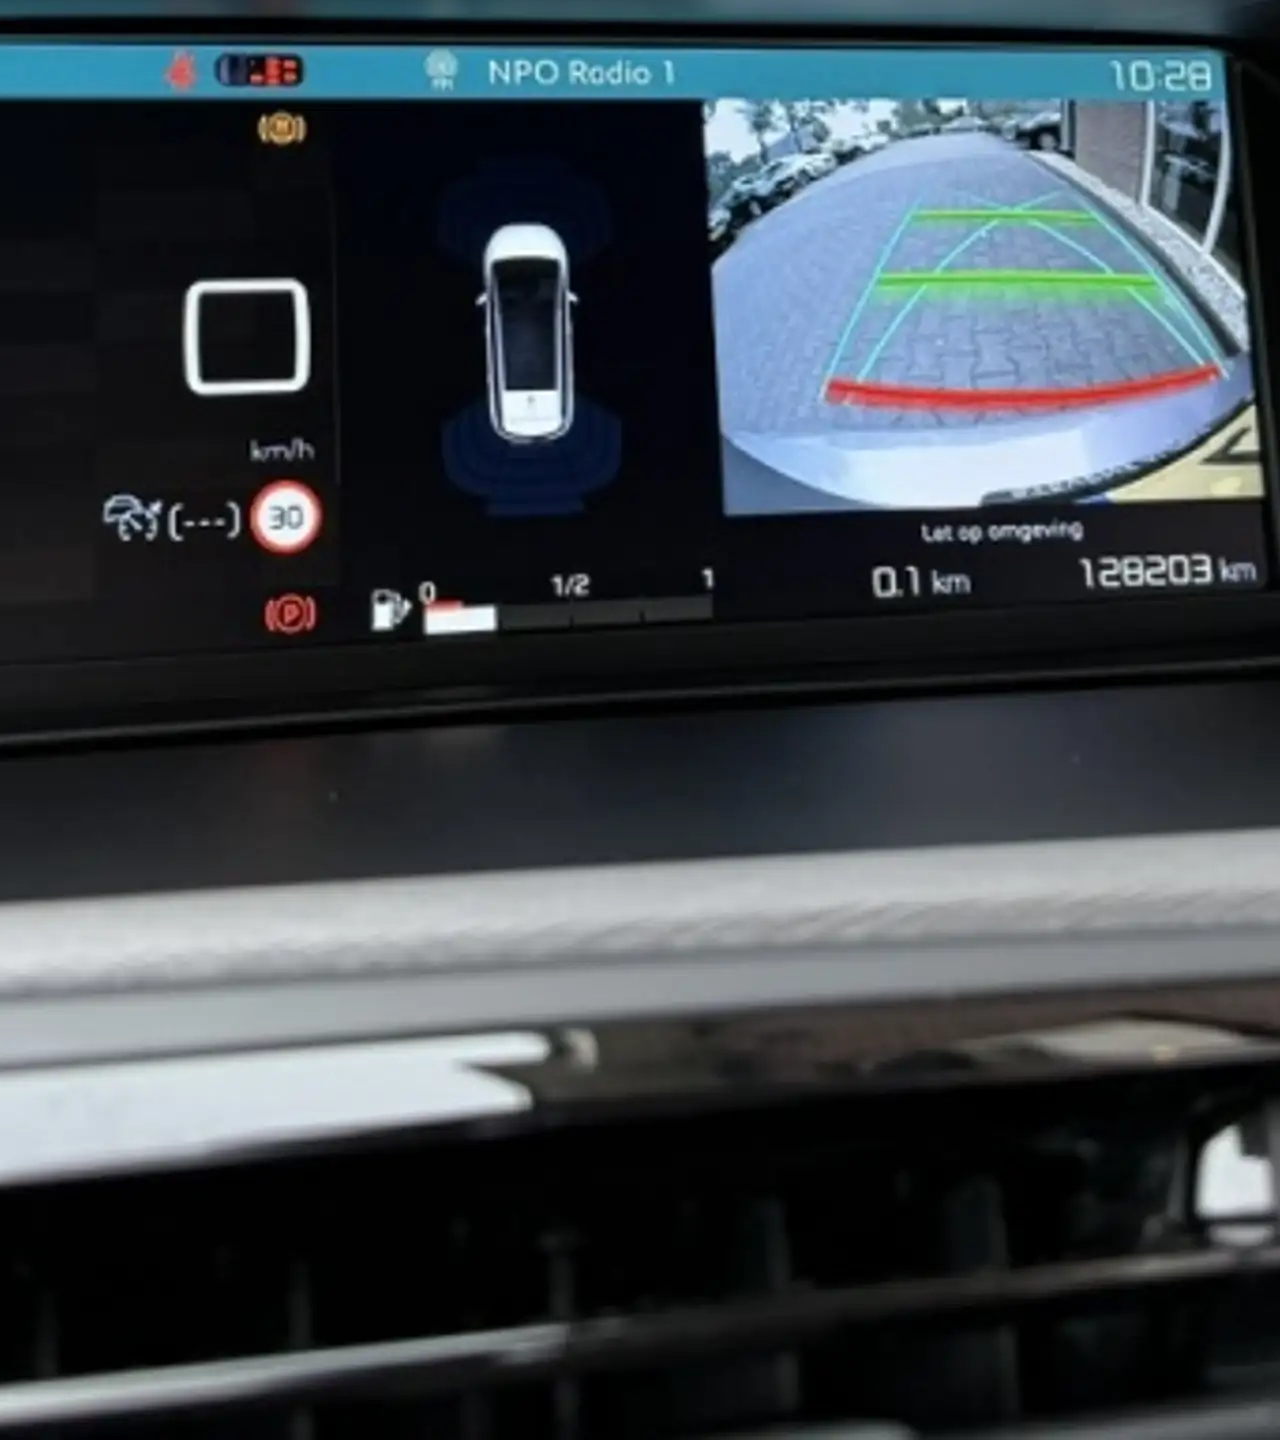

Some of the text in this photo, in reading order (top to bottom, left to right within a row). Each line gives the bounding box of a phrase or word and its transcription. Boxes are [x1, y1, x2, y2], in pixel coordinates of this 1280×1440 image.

[488, 59, 675, 85] NPO Radio 1
[1109, 60, 1211, 91] 10:28
[250, 438, 315, 461] km/h
[269, 506, 305, 530] 30
[922, 524, 951, 543] Let
[988, 518, 1084, 543] omgeving
[871, 565, 971, 599] 0.1 km
[1079, 554, 1257, 589] 128203 km
[551, 574, 590, 597] 1/2
